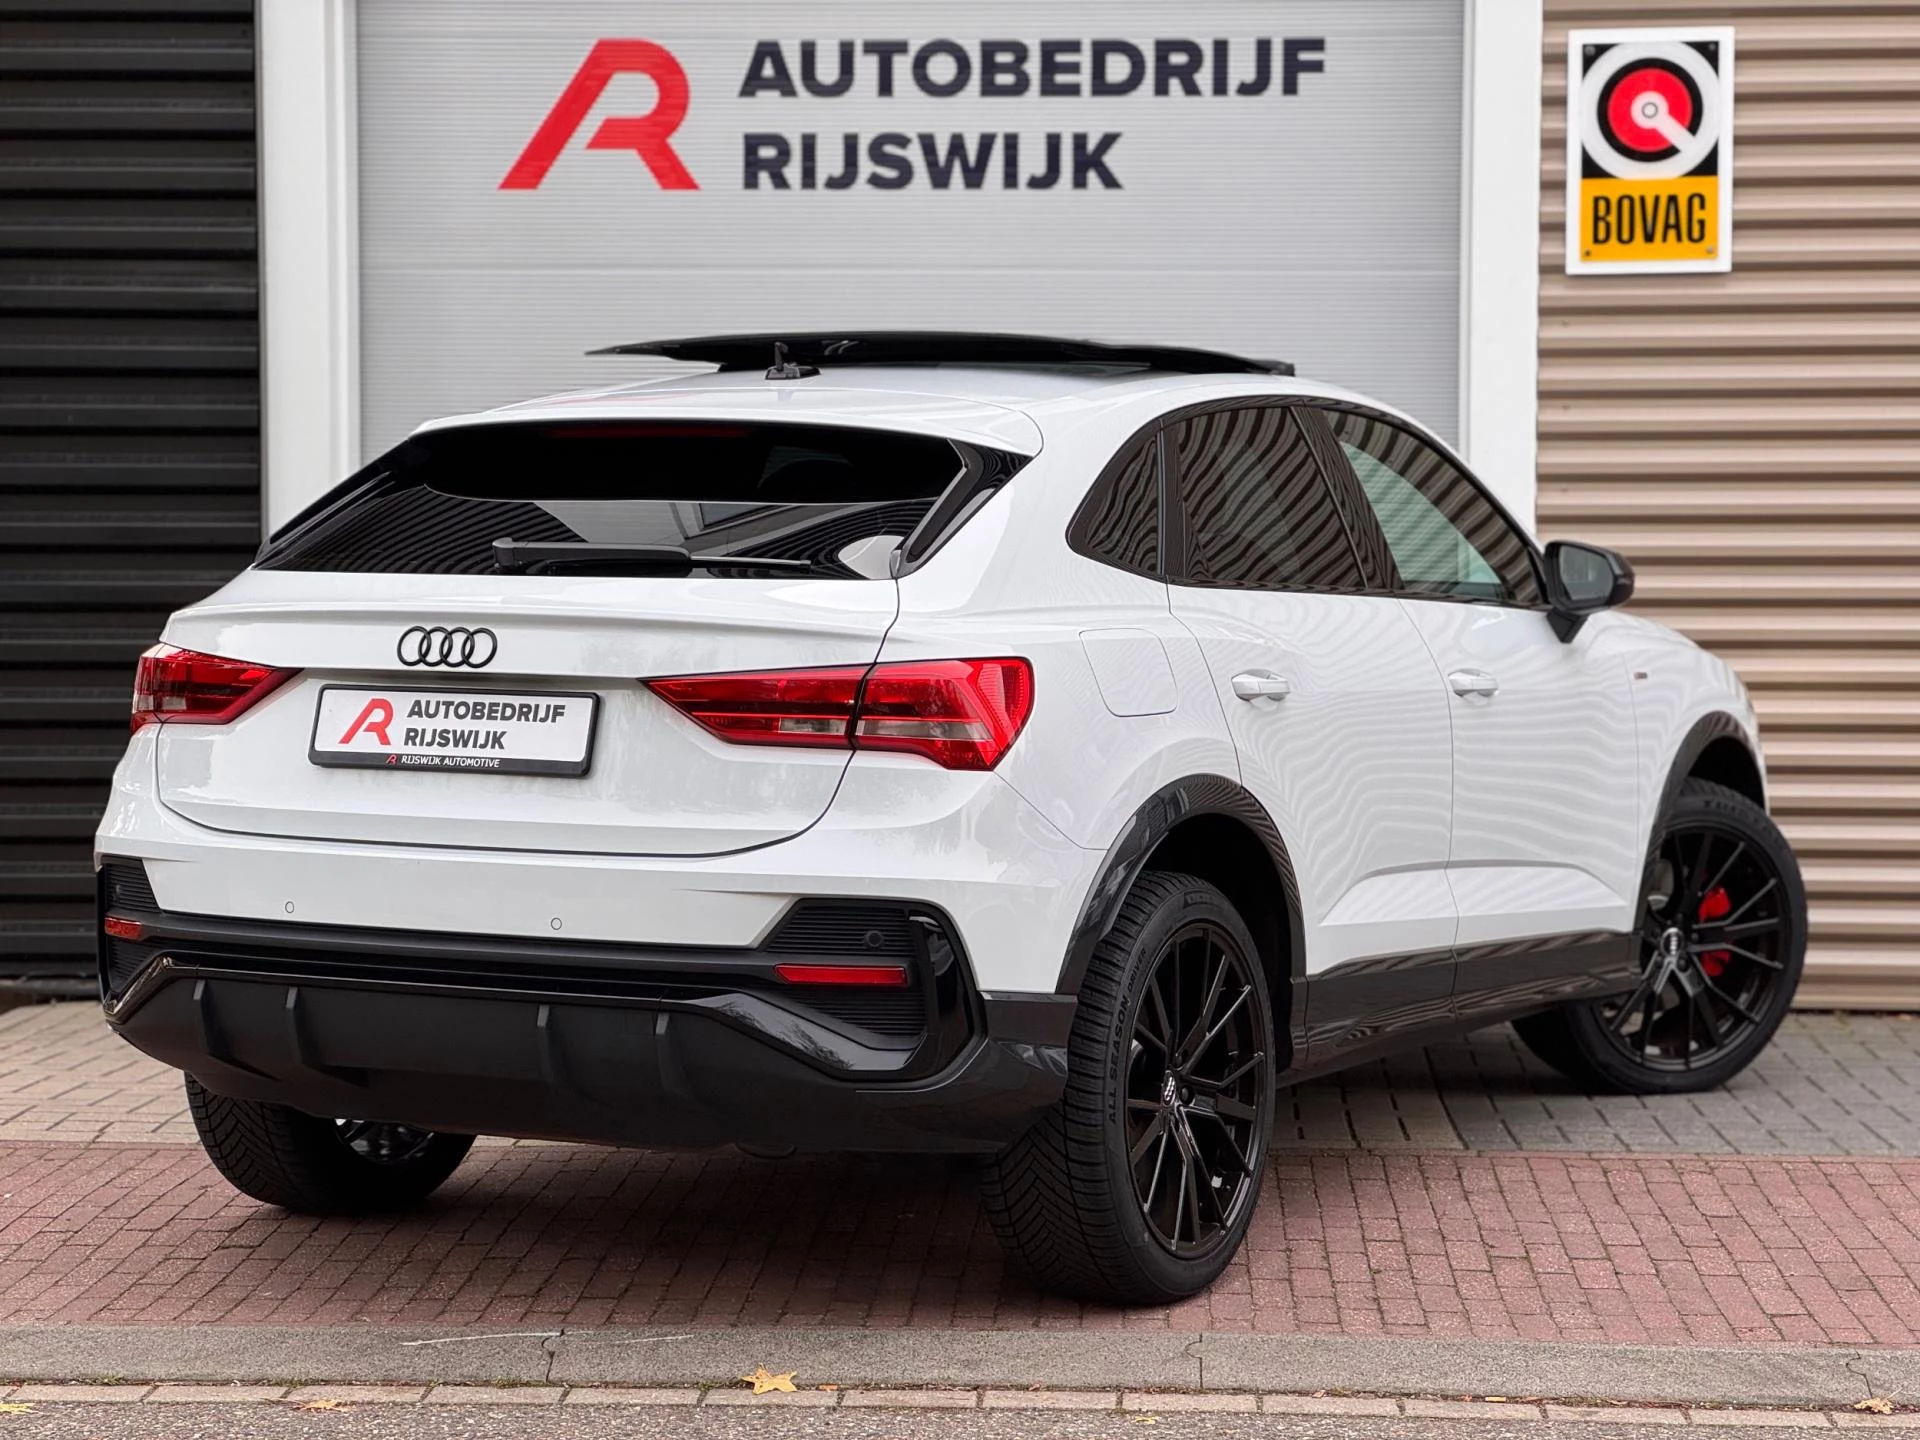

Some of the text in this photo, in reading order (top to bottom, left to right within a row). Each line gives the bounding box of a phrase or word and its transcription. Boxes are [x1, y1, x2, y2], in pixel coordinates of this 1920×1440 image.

[738, 37, 1325, 97] AUTOBEDRIJF
[742, 131, 1124, 190] RIJSWIJK
[1592, 193, 1706, 244] BOVAG
[407, 699, 566, 723] AUTOBEDRIJF
[401, 755, 500, 768] RIJSWIJK AUTOMOTIVE
[403, 727, 507, 750] RIJSWIJK
[1108, 946, 1147, 1124] ALL SEASON DRIVER
